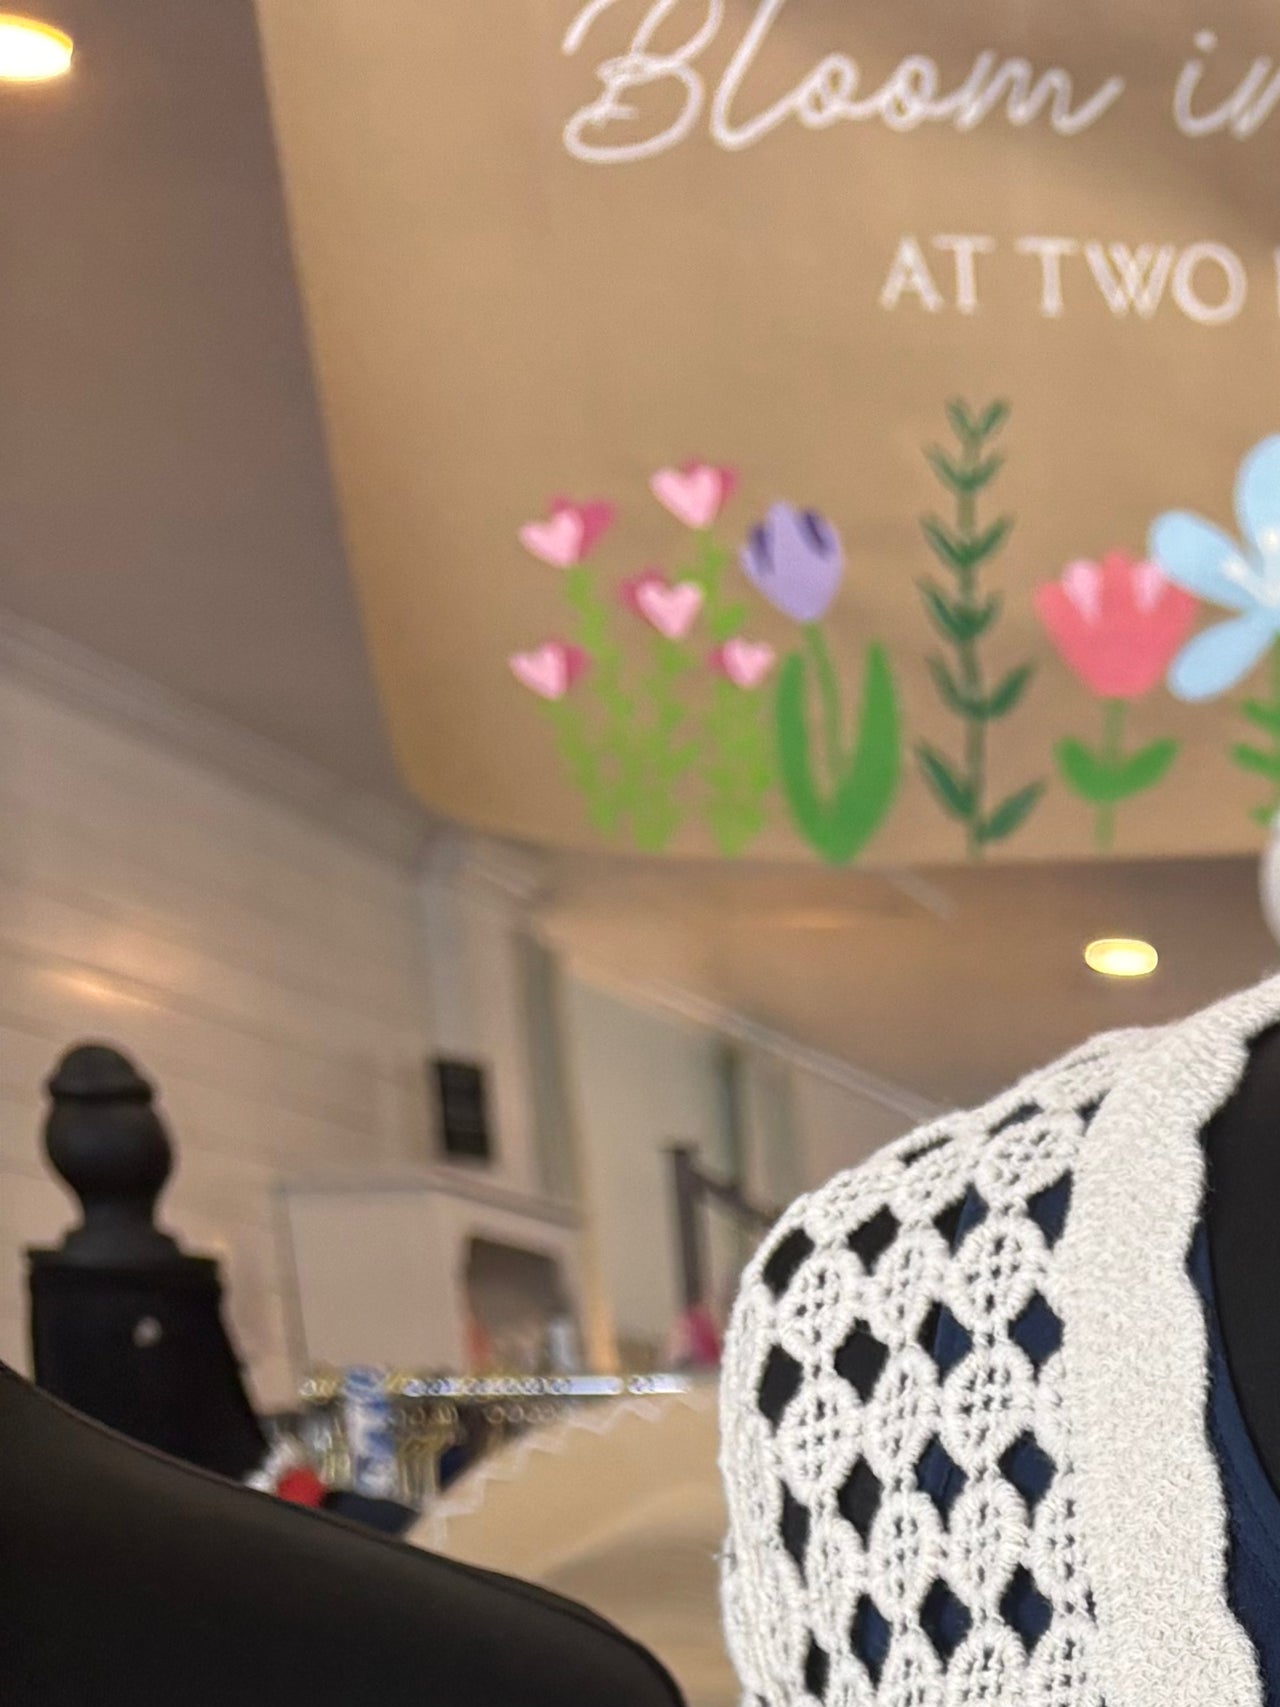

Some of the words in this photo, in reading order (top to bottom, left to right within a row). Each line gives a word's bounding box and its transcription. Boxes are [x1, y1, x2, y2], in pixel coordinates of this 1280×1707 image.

[561, 0, 1126, 164] Bloom
[880, 233, 995, 316] AT
[1013, 236, 1248, 325] TWO
